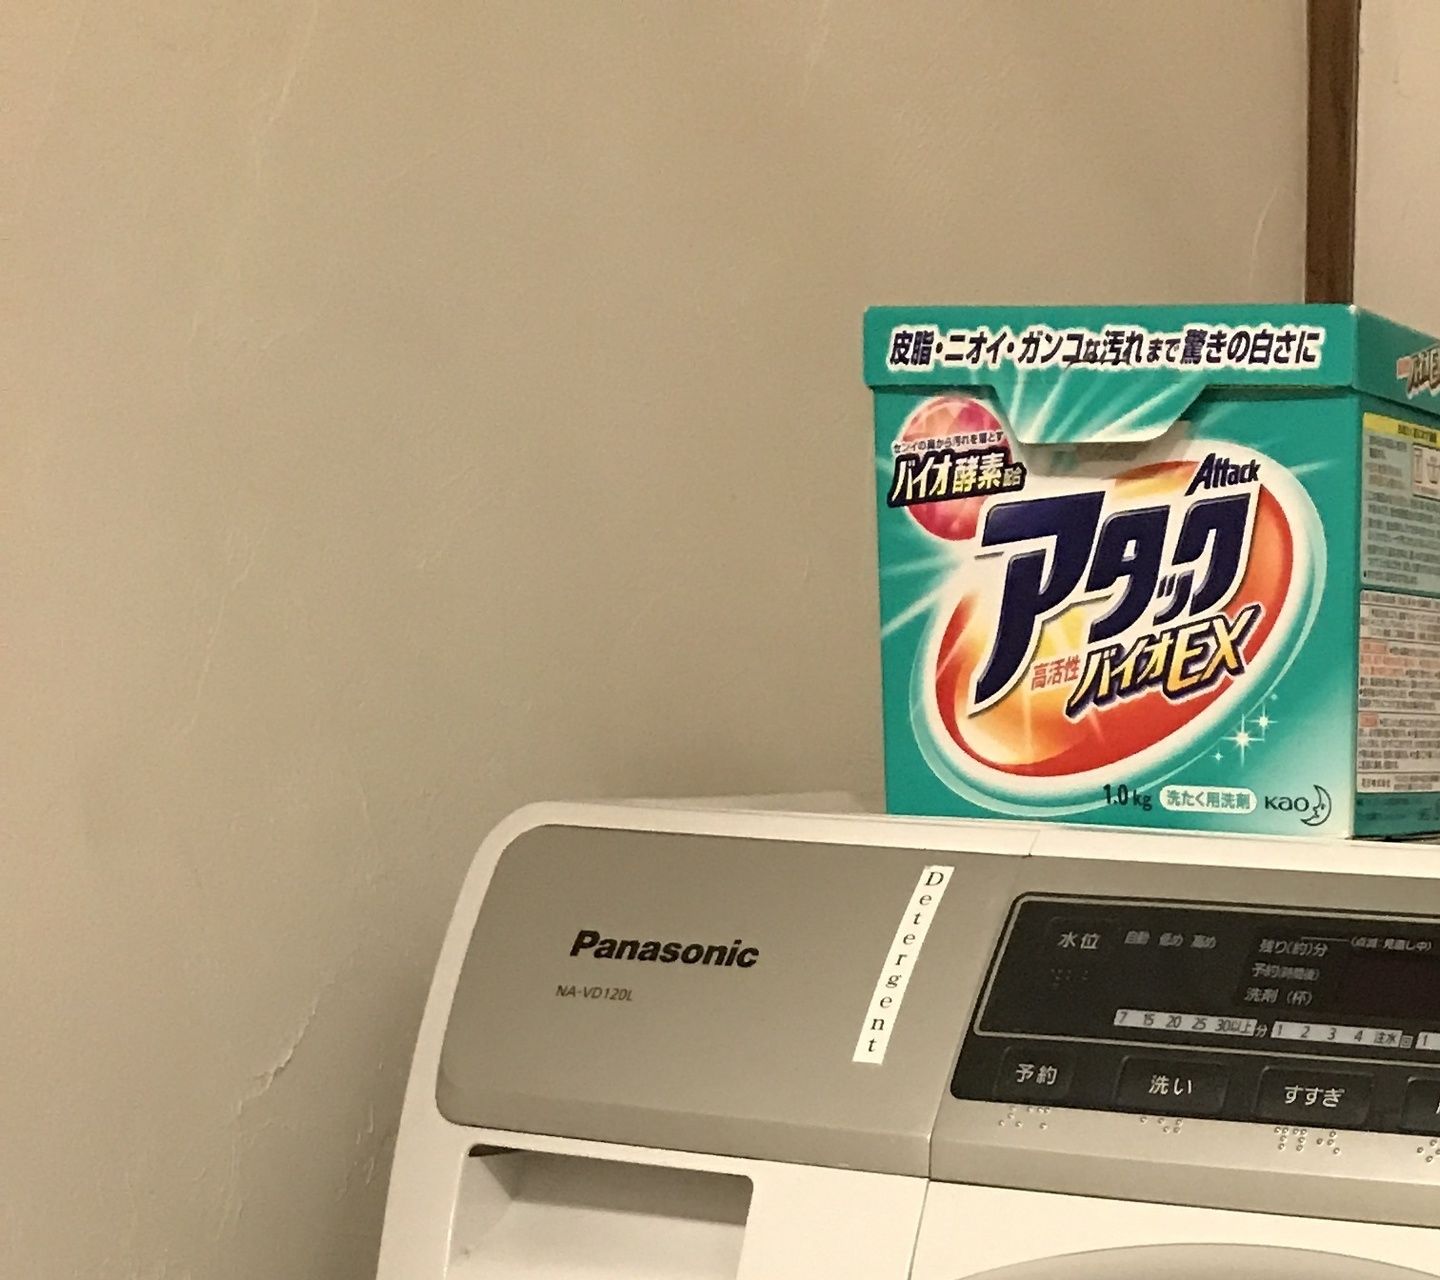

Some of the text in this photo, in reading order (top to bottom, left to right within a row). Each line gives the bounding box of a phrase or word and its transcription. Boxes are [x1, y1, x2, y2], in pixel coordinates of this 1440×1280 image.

[1185, 452, 1260, 496] Attack
[974, 491, 1250, 704] アタック
[1031, 655, 1081, 690] 高活性
[1166, 788, 1250, 810] 洗たく用洗剤
[570, 930, 760, 968] Panasonic
[1057, 931, 1100, 950] 水位
[867, 870, 945, 1055] Detergent
[555, 984, 634, 1001] NA-VD120L
[1118, 1011, 1128, 1023] 7
[1165, 1015, 1182, 1029] 20
[1190, 1017, 1207, 1030] 25
[1300, 1025, 1311, 1039] 2
[1326, 1028, 1337, 1041] 3
[1353, 1029, 1364, 1043] 4
[1015, 1063, 1058, 1085] 予約
[1148, 1074, 1193, 1095] 洗い
[1284, 1085, 1346, 1107] すすぎ
